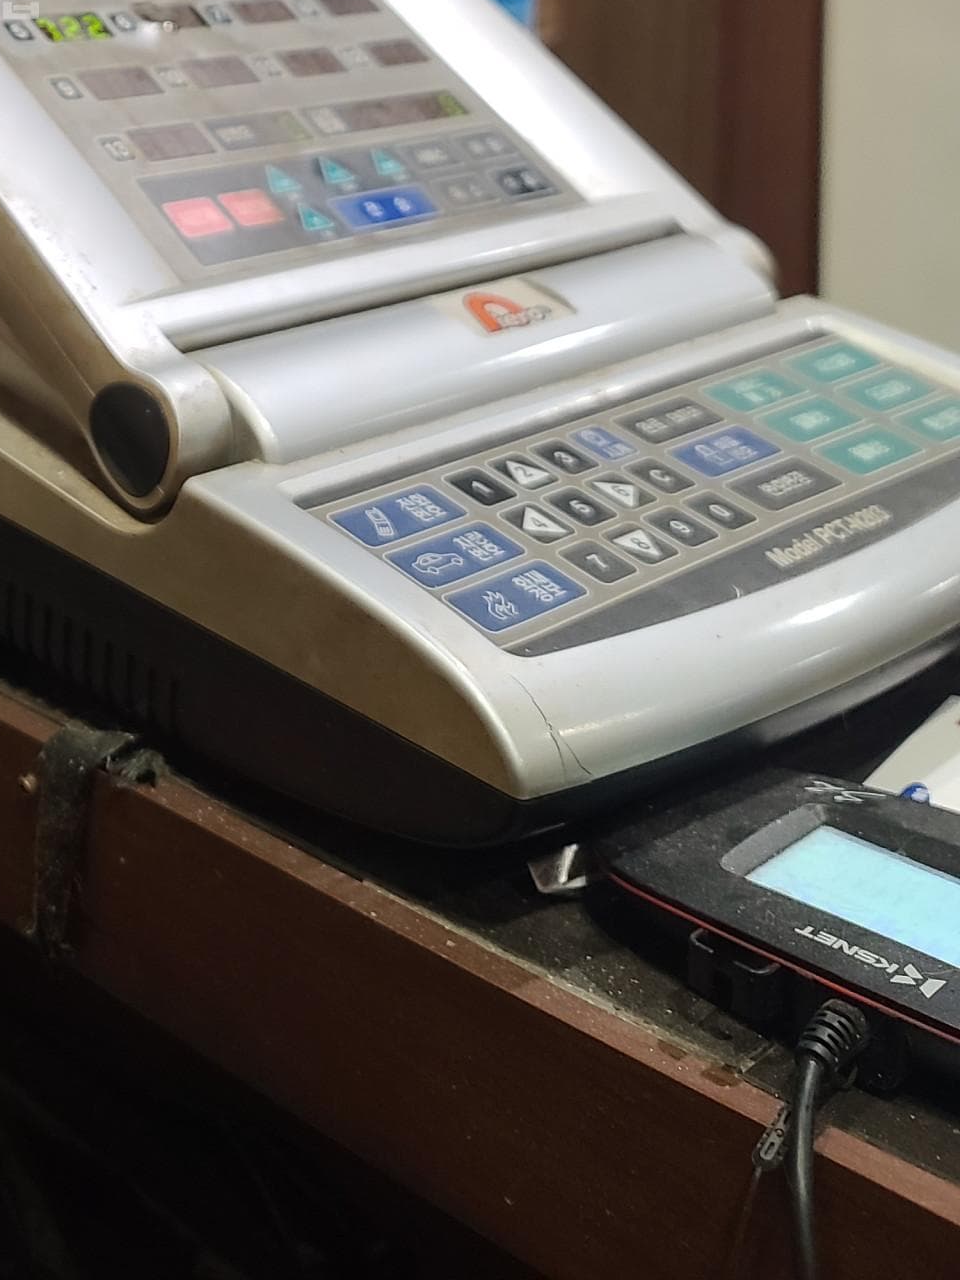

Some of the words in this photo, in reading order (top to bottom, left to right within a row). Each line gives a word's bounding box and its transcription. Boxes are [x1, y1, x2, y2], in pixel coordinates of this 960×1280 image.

[472, 480, 493, 494] 1
[514, 466, 533, 478] 2
[553, 451, 575, 464] 3
[531, 517, 549, 529] 4
[569, 500, 591, 513] 5
[611, 485, 630, 498] 6
[585, 553, 608, 569] 7
[669, 520, 690, 533] 9
[794, 925, 899, 974] KSNET
